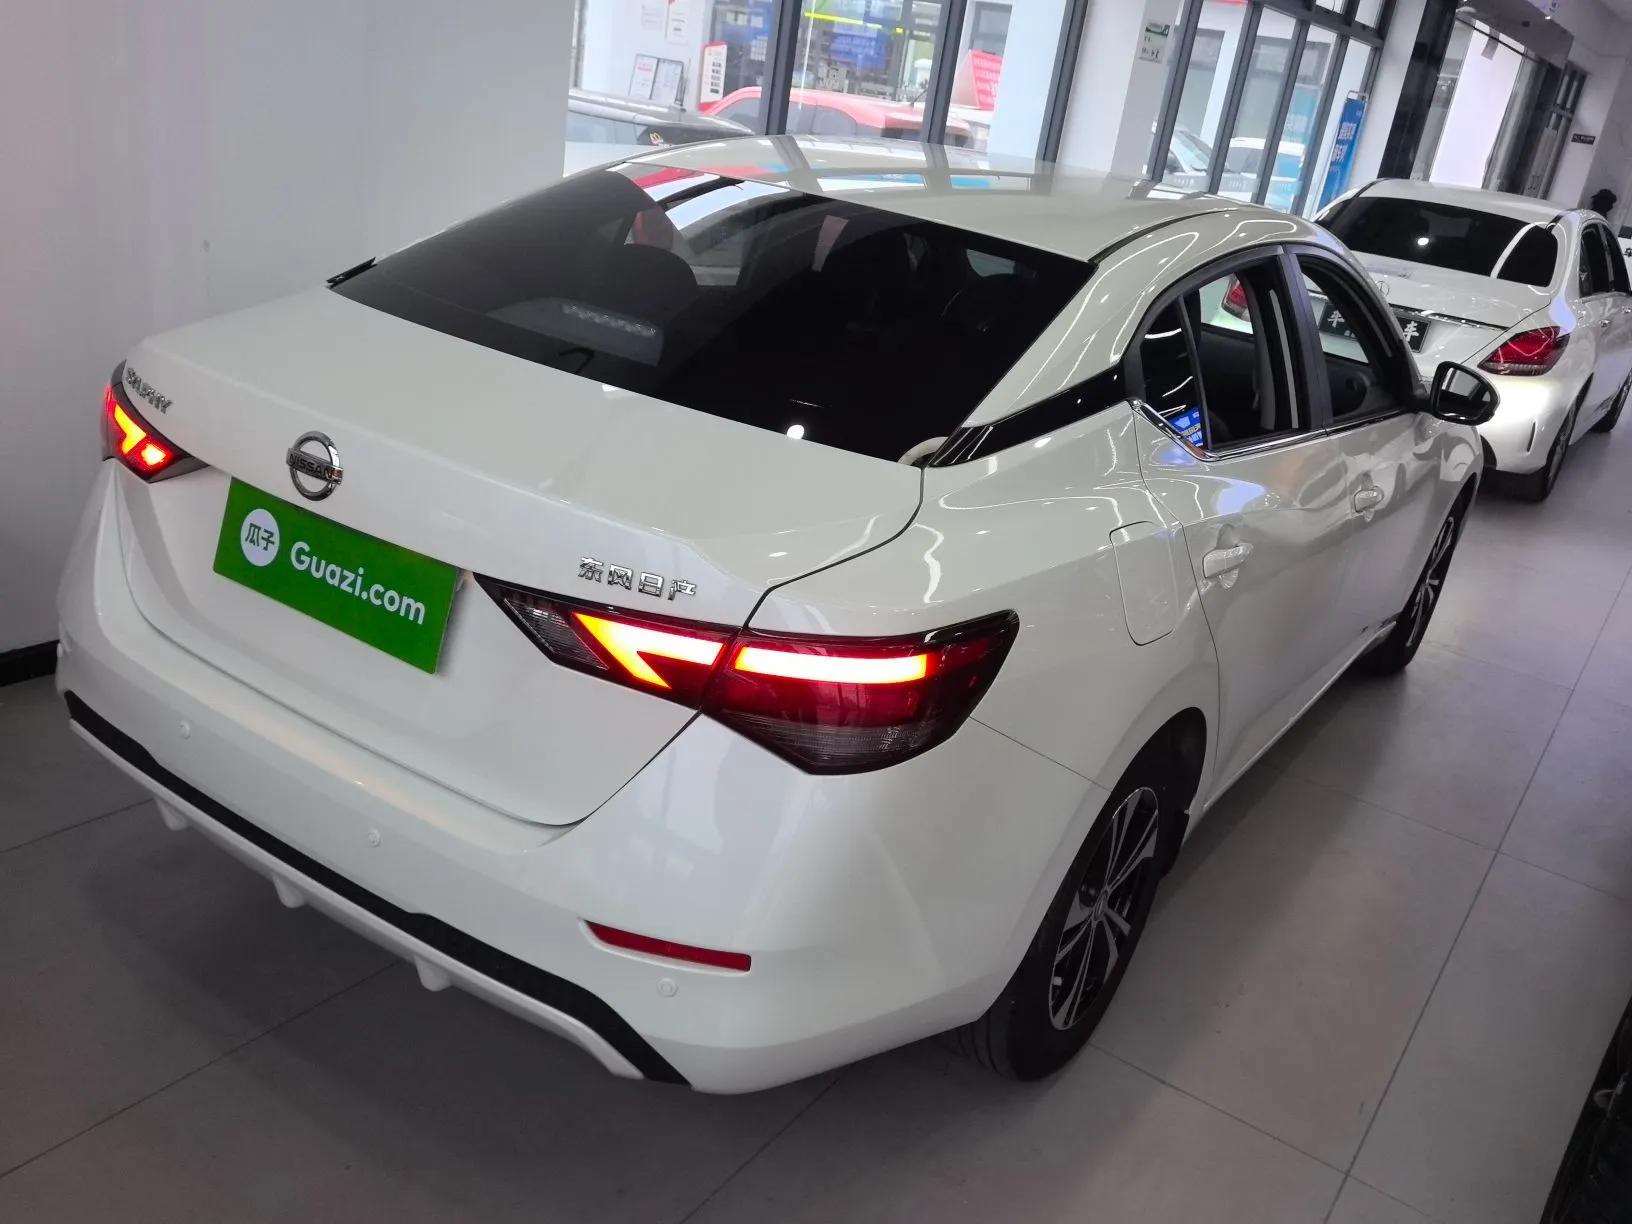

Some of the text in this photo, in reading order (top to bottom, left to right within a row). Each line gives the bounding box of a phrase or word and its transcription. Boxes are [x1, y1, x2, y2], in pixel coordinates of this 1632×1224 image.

[289, 452, 333, 481] NISSAN
[244, 522, 275, 552] 瓜子
[290, 541, 426, 625] Guazi.com
[578, 557, 697, 601] 东风日产
